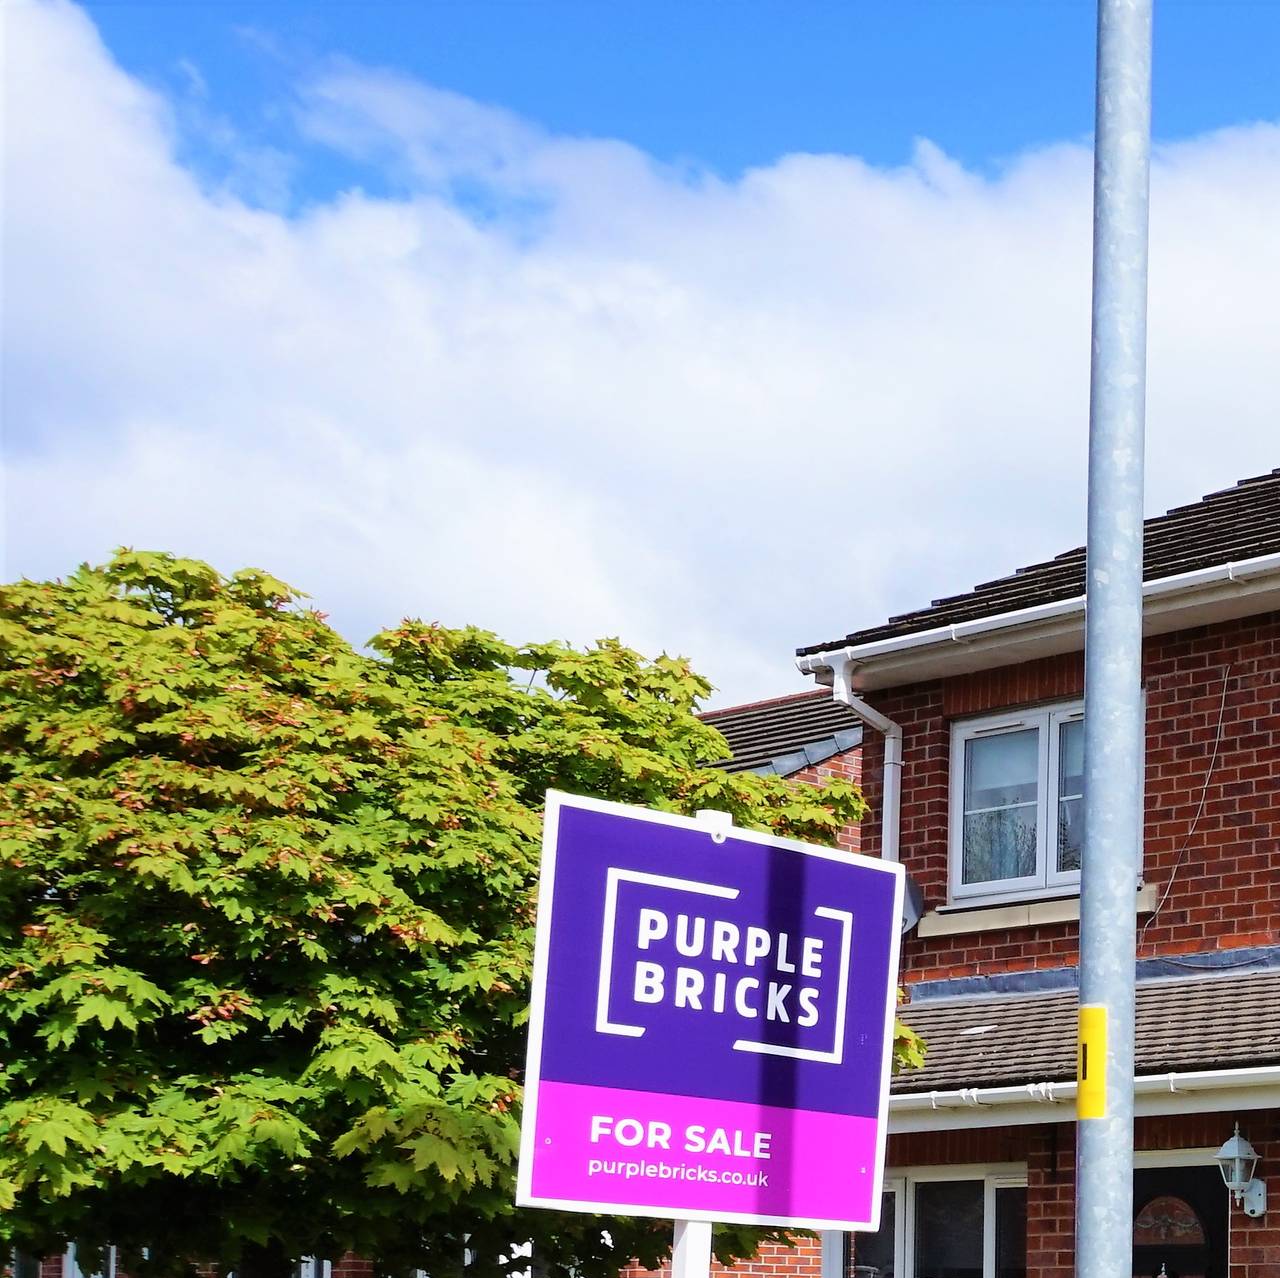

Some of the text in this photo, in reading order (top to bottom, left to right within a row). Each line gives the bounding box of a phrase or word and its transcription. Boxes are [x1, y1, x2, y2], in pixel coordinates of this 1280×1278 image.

[637, 908, 824, 978] PURPLE
[633, 961, 820, 1027] BRICKS
[590, 1115, 772, 1159] FOR SALE
[588, 1158, 769, 1187] purplebricks.co.uk
